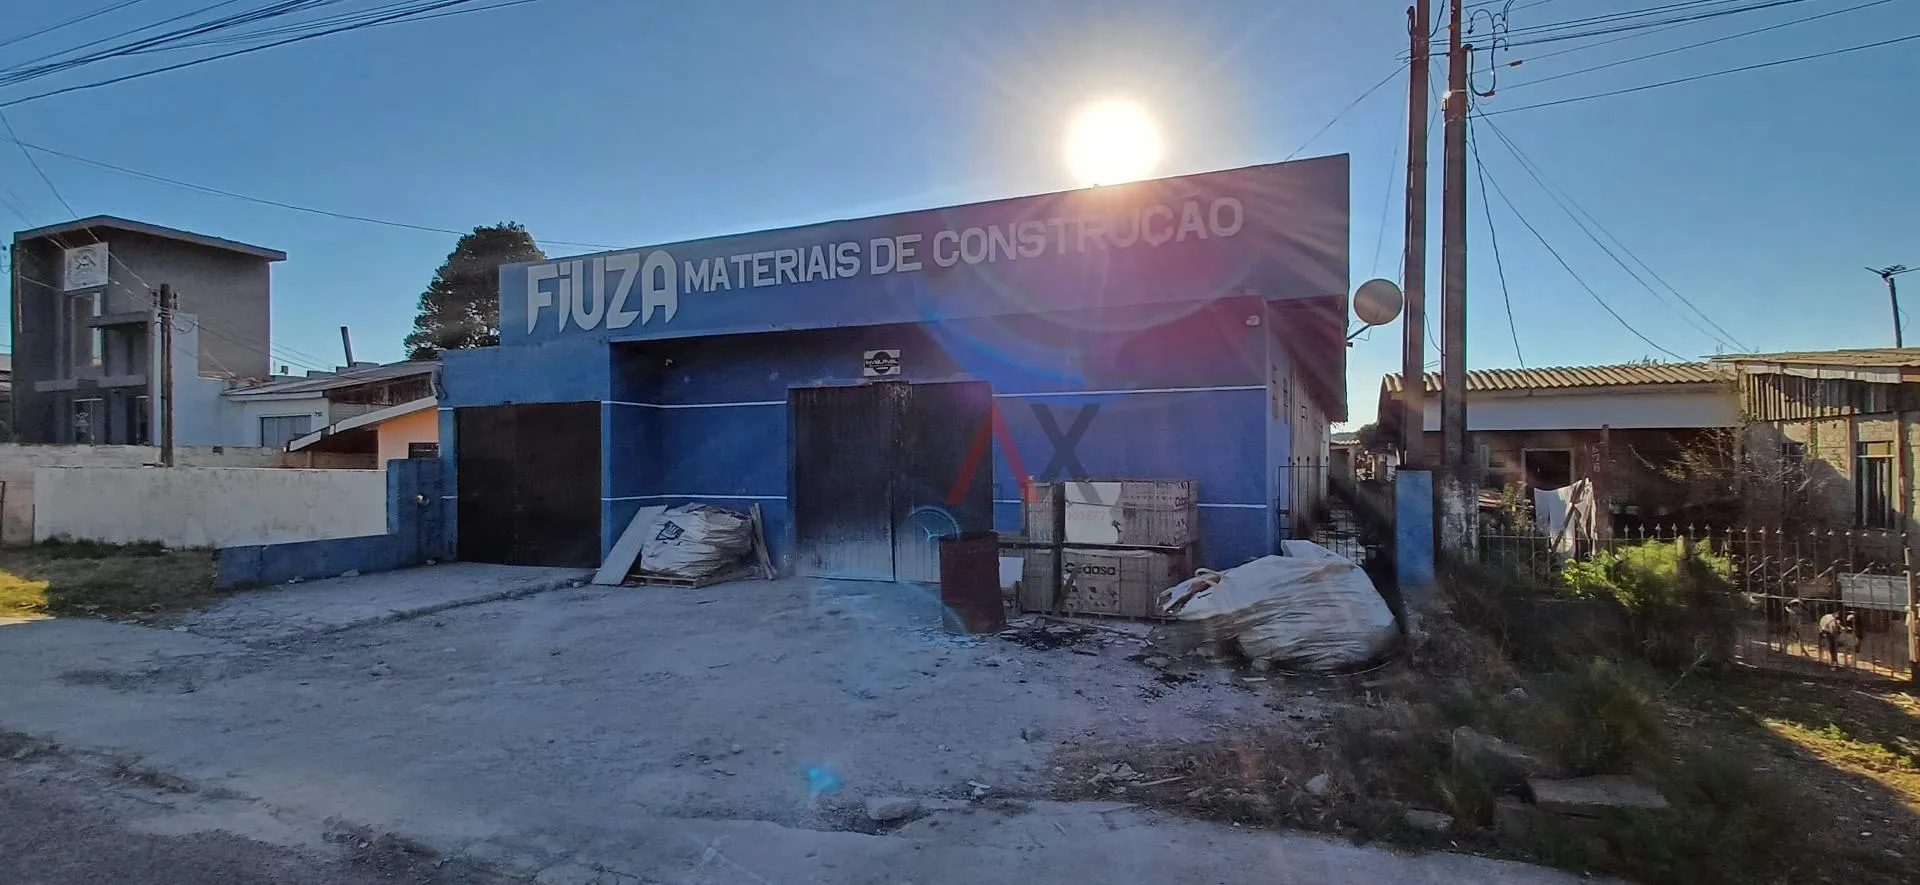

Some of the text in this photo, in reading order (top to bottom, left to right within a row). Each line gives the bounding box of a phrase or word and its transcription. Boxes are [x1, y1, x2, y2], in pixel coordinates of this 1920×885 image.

[685, 242, 861, 294] MATERIAIS
[870, 233, 922, 275] DE
[933, 190, 1243, 268] CONSTRUÇÃO
[1064, 562, 1116, 576] Cdasa
